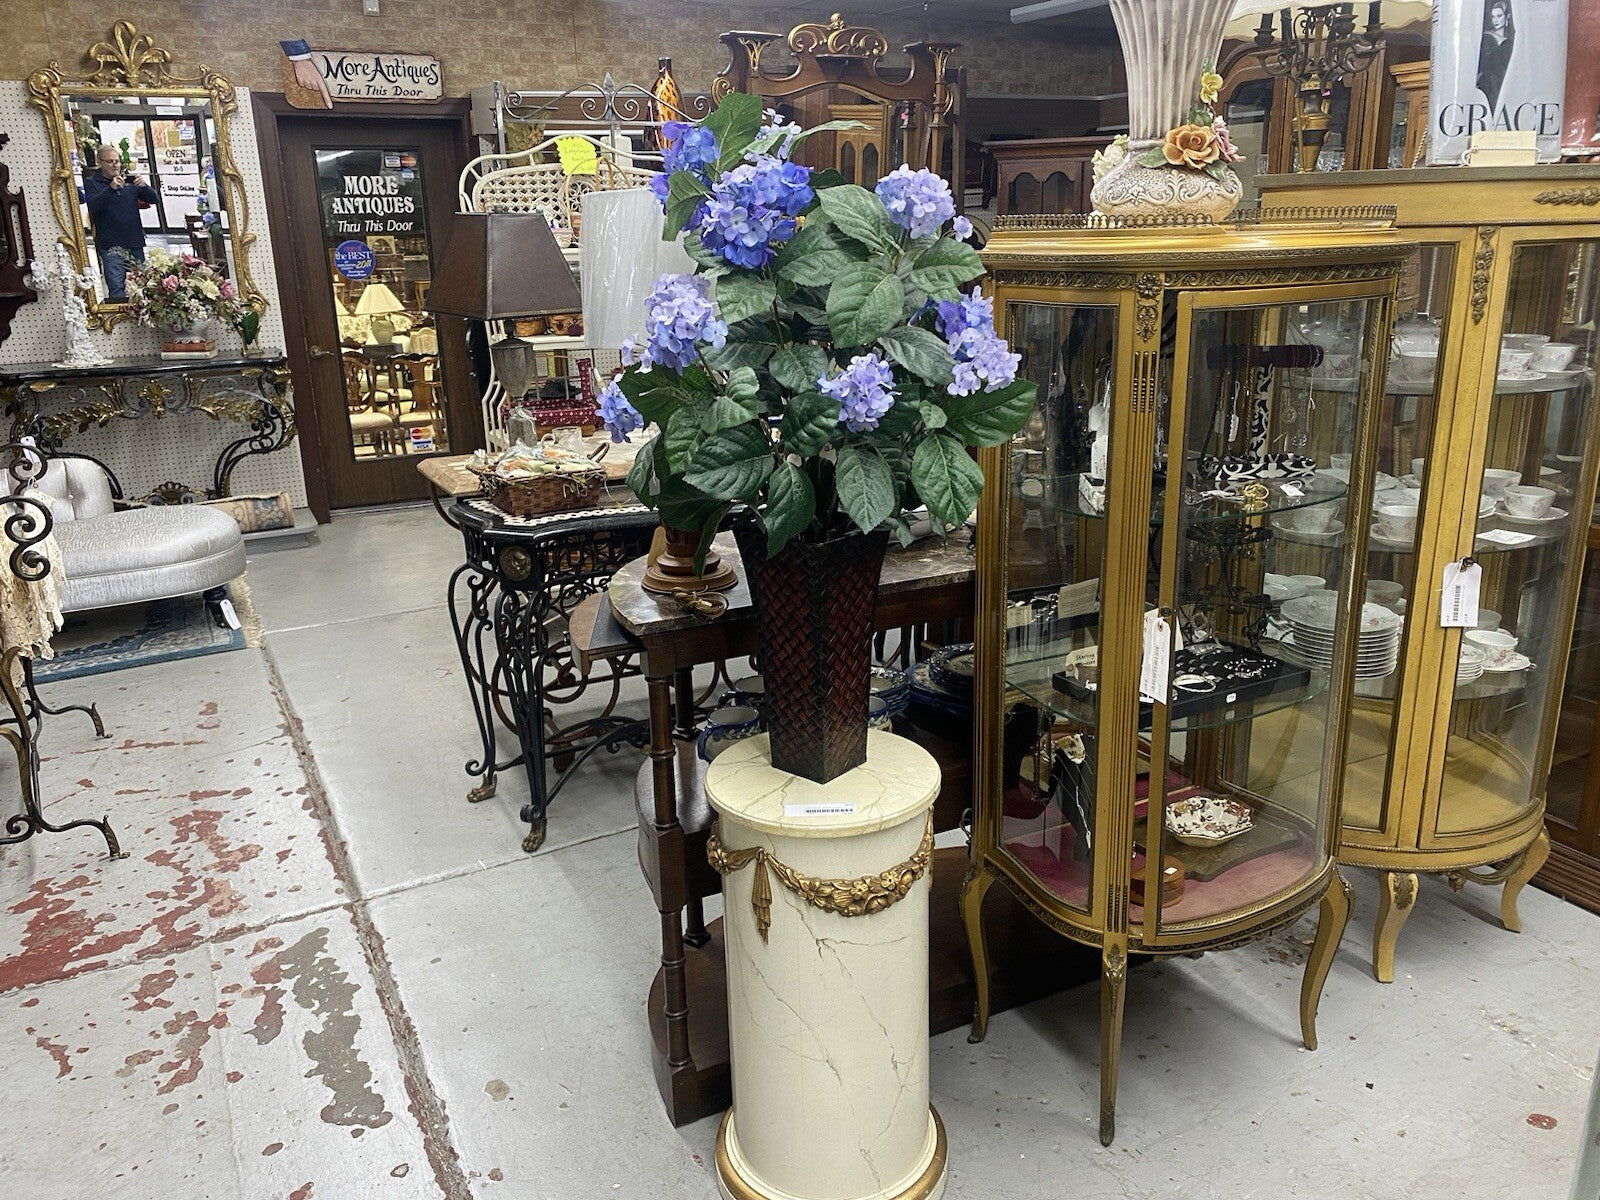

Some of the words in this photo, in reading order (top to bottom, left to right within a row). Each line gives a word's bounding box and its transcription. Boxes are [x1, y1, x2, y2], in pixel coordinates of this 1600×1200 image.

[322, 55, 370, 81] More
[367, 56, 439, 85] Antiques
[337, 84, 361, 95] Thru
[365, 85, 388, 96] This
[393, 86, 423, 97] Door
[1438, 102, 1560, 137] GRACE
[343, 175, 399, 196] MORE
[332, 196, 415, 216] ANTIQUES
[338, 220, 361, 232] Thru
[364, 220, 384, 232] This
[386, 220, 413, 231] Door
[335, 251, 347, 260] the
[348, 251, 372, 260] BEST
